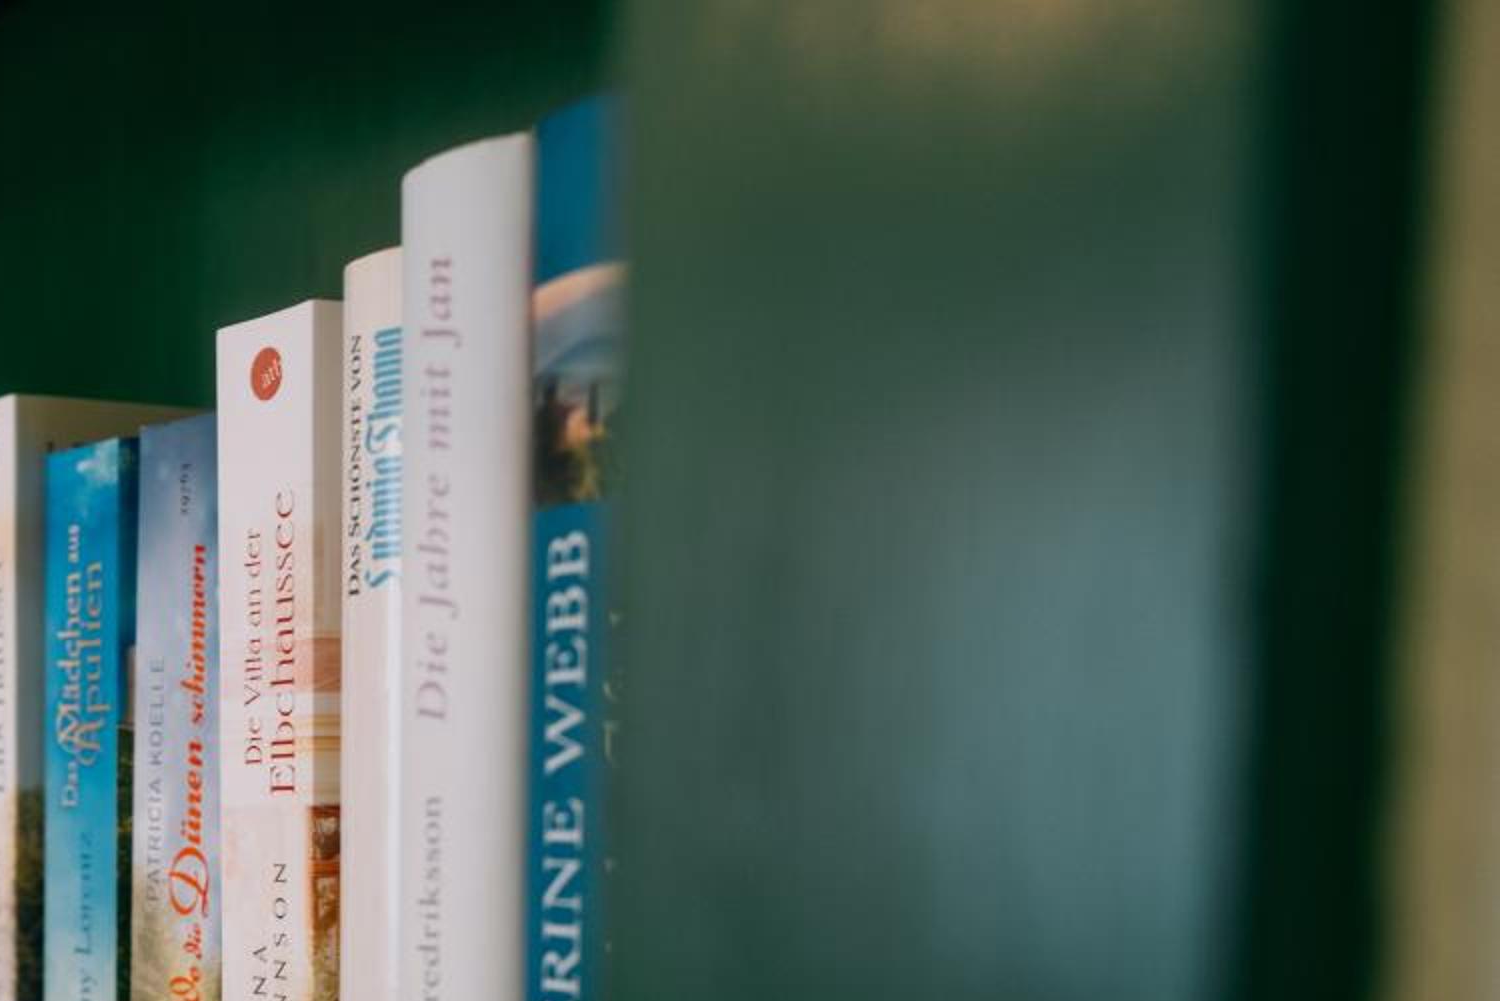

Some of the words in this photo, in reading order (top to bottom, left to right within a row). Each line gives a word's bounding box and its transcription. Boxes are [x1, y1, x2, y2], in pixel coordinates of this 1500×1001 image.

[422, 257, 461, 349] Jan
[420, 365, 452, 451] mit
[67, 524, 80, 563] aus
[244, 530, 262, 571] der
[416, 474, 458, 620] Jahre
[180, 544, 206, 724] schimmern
[249, 589, 262, 628] an
[270, 484, 295, 793] Elbchaussee
[545, 530, 590, 776] WEBB
[75, 560, 111, 767] Apulien
[244, 638, 262, 708] Villa
[416, 630, 449, 722] Die
[148, 656, 165, 766] KOELLE
[244, 717, 262, 765] Die
[61, 761, 79, 806] Das
[167, 741, 209, 918] Dünen
[147, 777, 164, 907] PATRICIA
[74, 831, 93, 955] Lorentz
[184, 923, 202, 960] die
